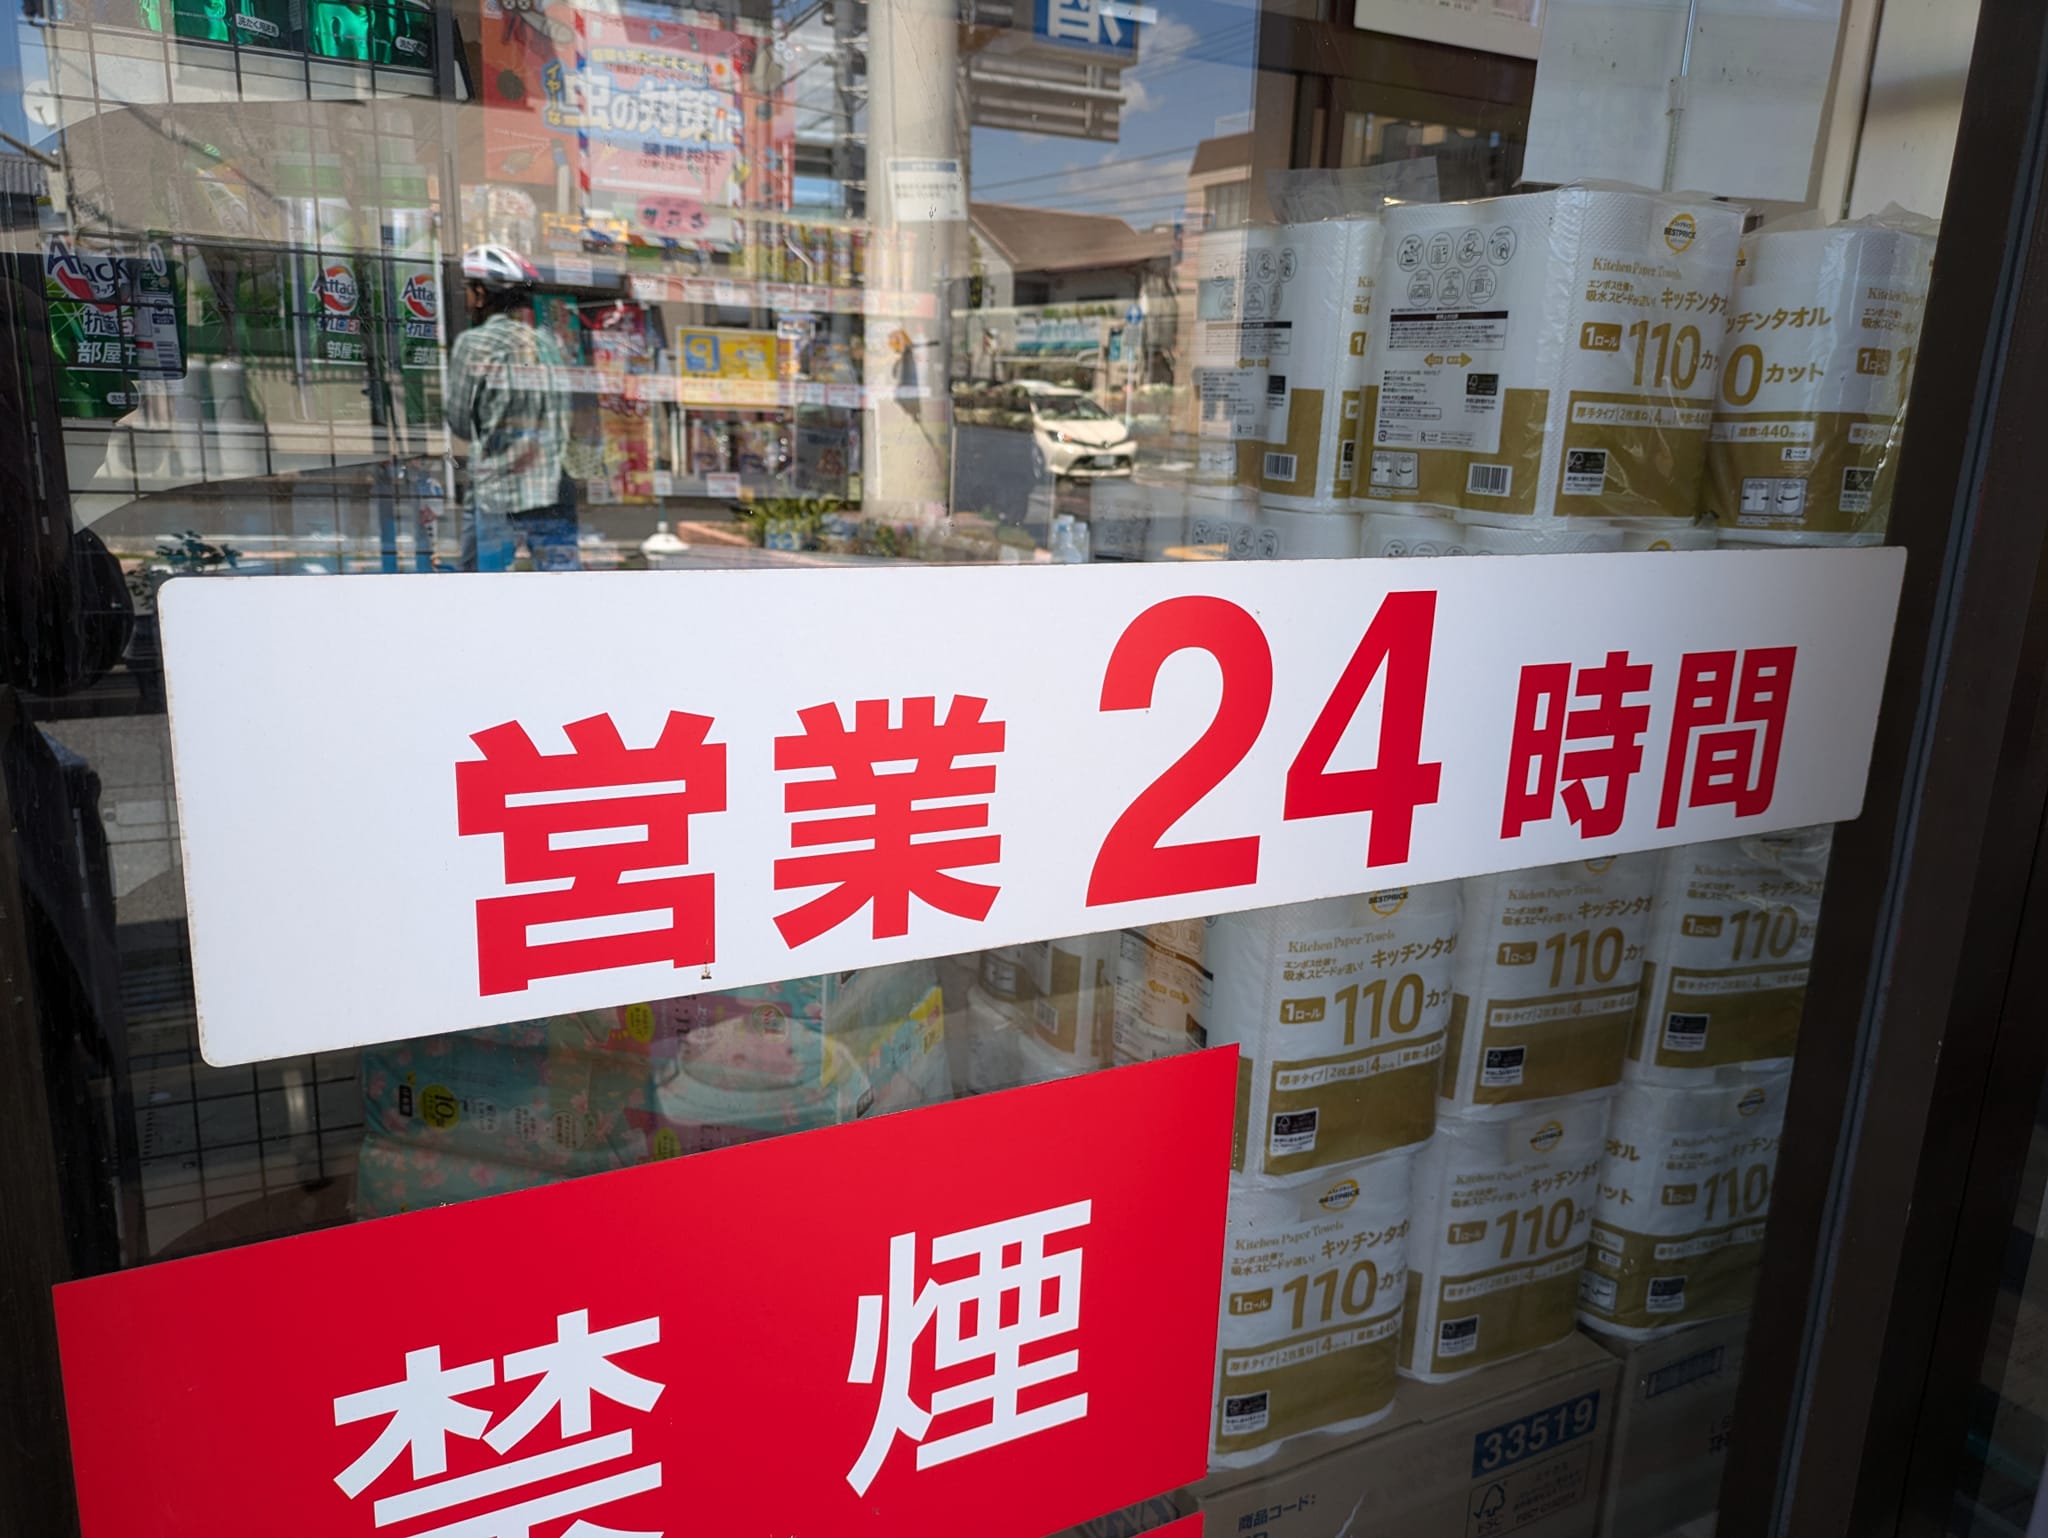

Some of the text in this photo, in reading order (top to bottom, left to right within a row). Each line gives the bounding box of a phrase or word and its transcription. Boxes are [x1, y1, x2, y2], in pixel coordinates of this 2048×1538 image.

[1664, 227, 1697, 240] BESTPRICE
[1592, 257, 1632, 273] Kitchen
[1633, 262, 1657, 277] Paper
[402, 277, 437, 300] Atta
[1585, 327, 1618, 348] 1ロール
[455, 590, 1797, 996] 営業24時間
[1368, 891, 1409, 905] BESTPRICE
[1288, 928, 1396, 953] Kitchen Paper Towels
[1285, 1002, 1322, 1022] 1ロール
[1704, 1163, 1768, 1221] 110
[1235, 1236, 1279, 1251] Kitchen
[1281, 1229, 1311, 1244] Paper
[1234, 1295, 1269, 1313] 1ロール
[332, 1199, 1092, 1538] 禁煙
[1480, 1397, 1594, 1469] 33519
